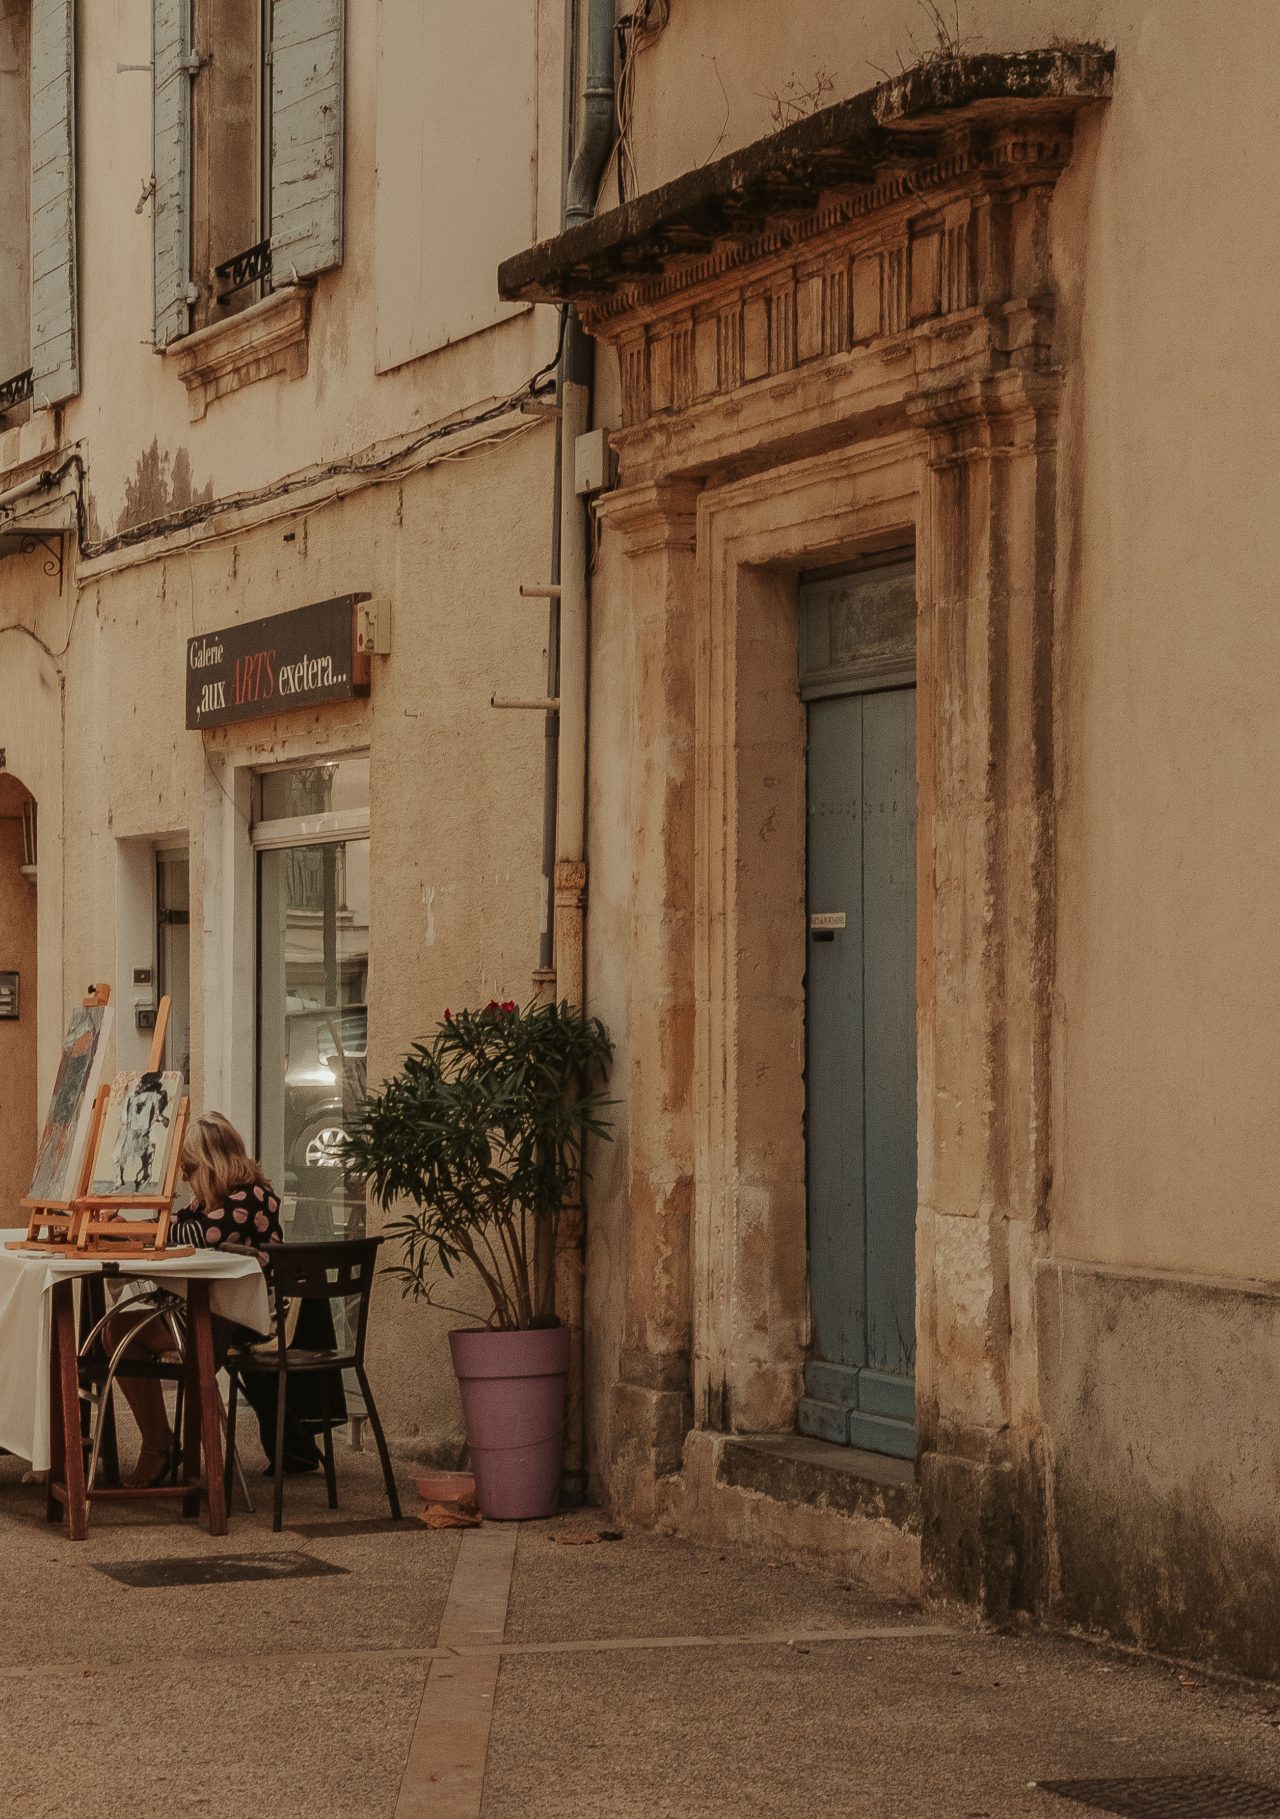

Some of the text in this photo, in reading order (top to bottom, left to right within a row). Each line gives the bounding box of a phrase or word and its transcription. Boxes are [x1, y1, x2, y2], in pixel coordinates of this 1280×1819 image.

[190, 636, 224, 670] Galerie
[232, 650, 277, 705] ARTS
[279, 654, 347, 696] exetera...
